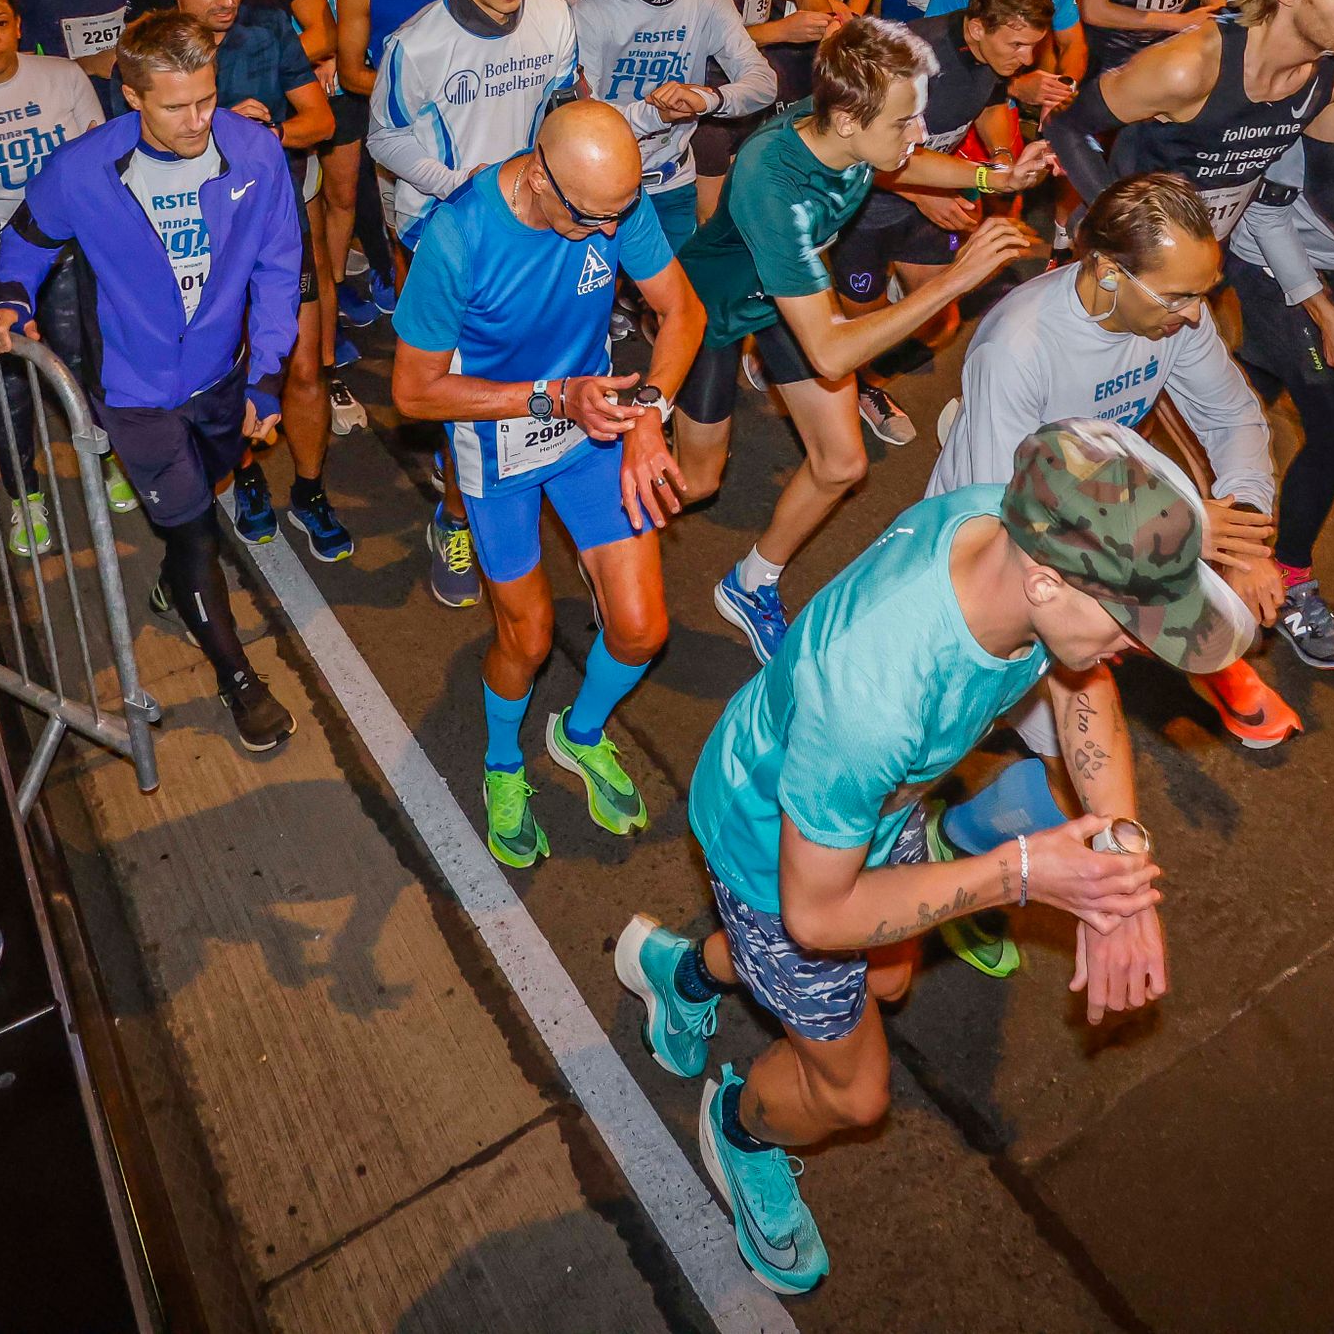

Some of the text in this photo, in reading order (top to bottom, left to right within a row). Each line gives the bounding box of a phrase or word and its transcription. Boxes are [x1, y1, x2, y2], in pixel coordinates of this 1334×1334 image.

[83, 25, 122, 45] 2267
[634, 29, 675, 44] ERSTE
[628, 49, 667, 59] vienna
[484, 53, 555, 79] Boehringer
[612, 51, 692, 83] night
[484, 73, 546, 98] Ingelheim
[1221, 122, 1301, 143] follow me
[1195, 151, 1220, 162] on
[151, 191, 197, 210] RSTE
[1094, 367, 1143, 403] ERSTE
[539, 437, 567, 454] Helmut
